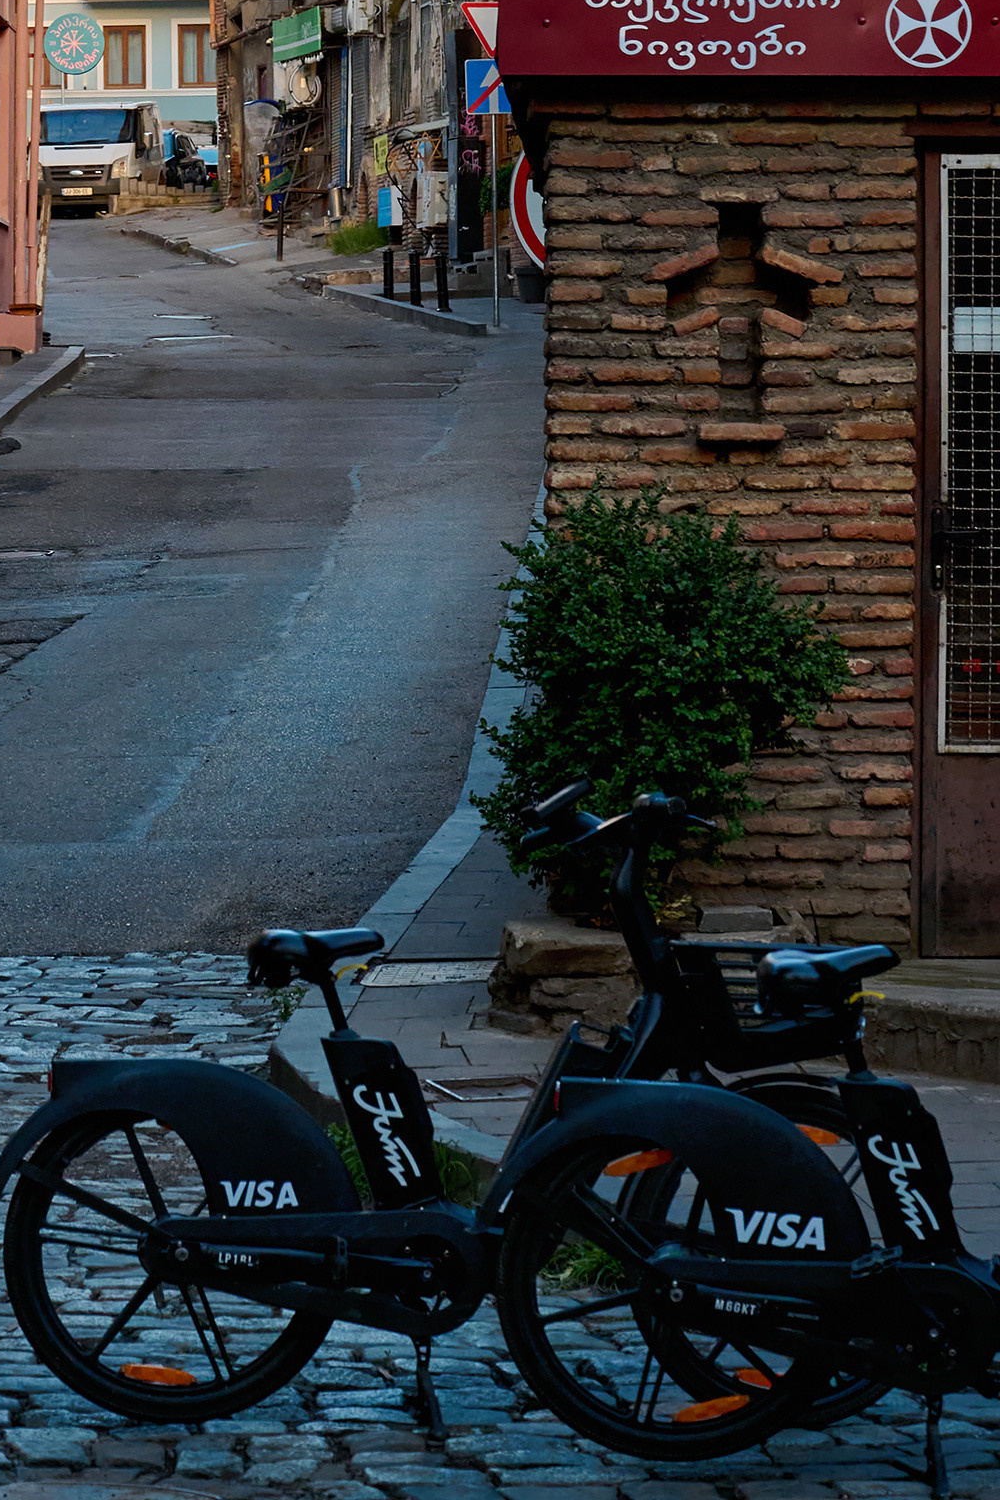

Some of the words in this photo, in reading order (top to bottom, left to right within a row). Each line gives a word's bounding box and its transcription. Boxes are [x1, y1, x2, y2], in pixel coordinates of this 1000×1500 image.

[618, 23, 807, 71] ნივთები
[219, 1180, 299, 1210] VISA
[724, 1207, 826, 1251] VISA
